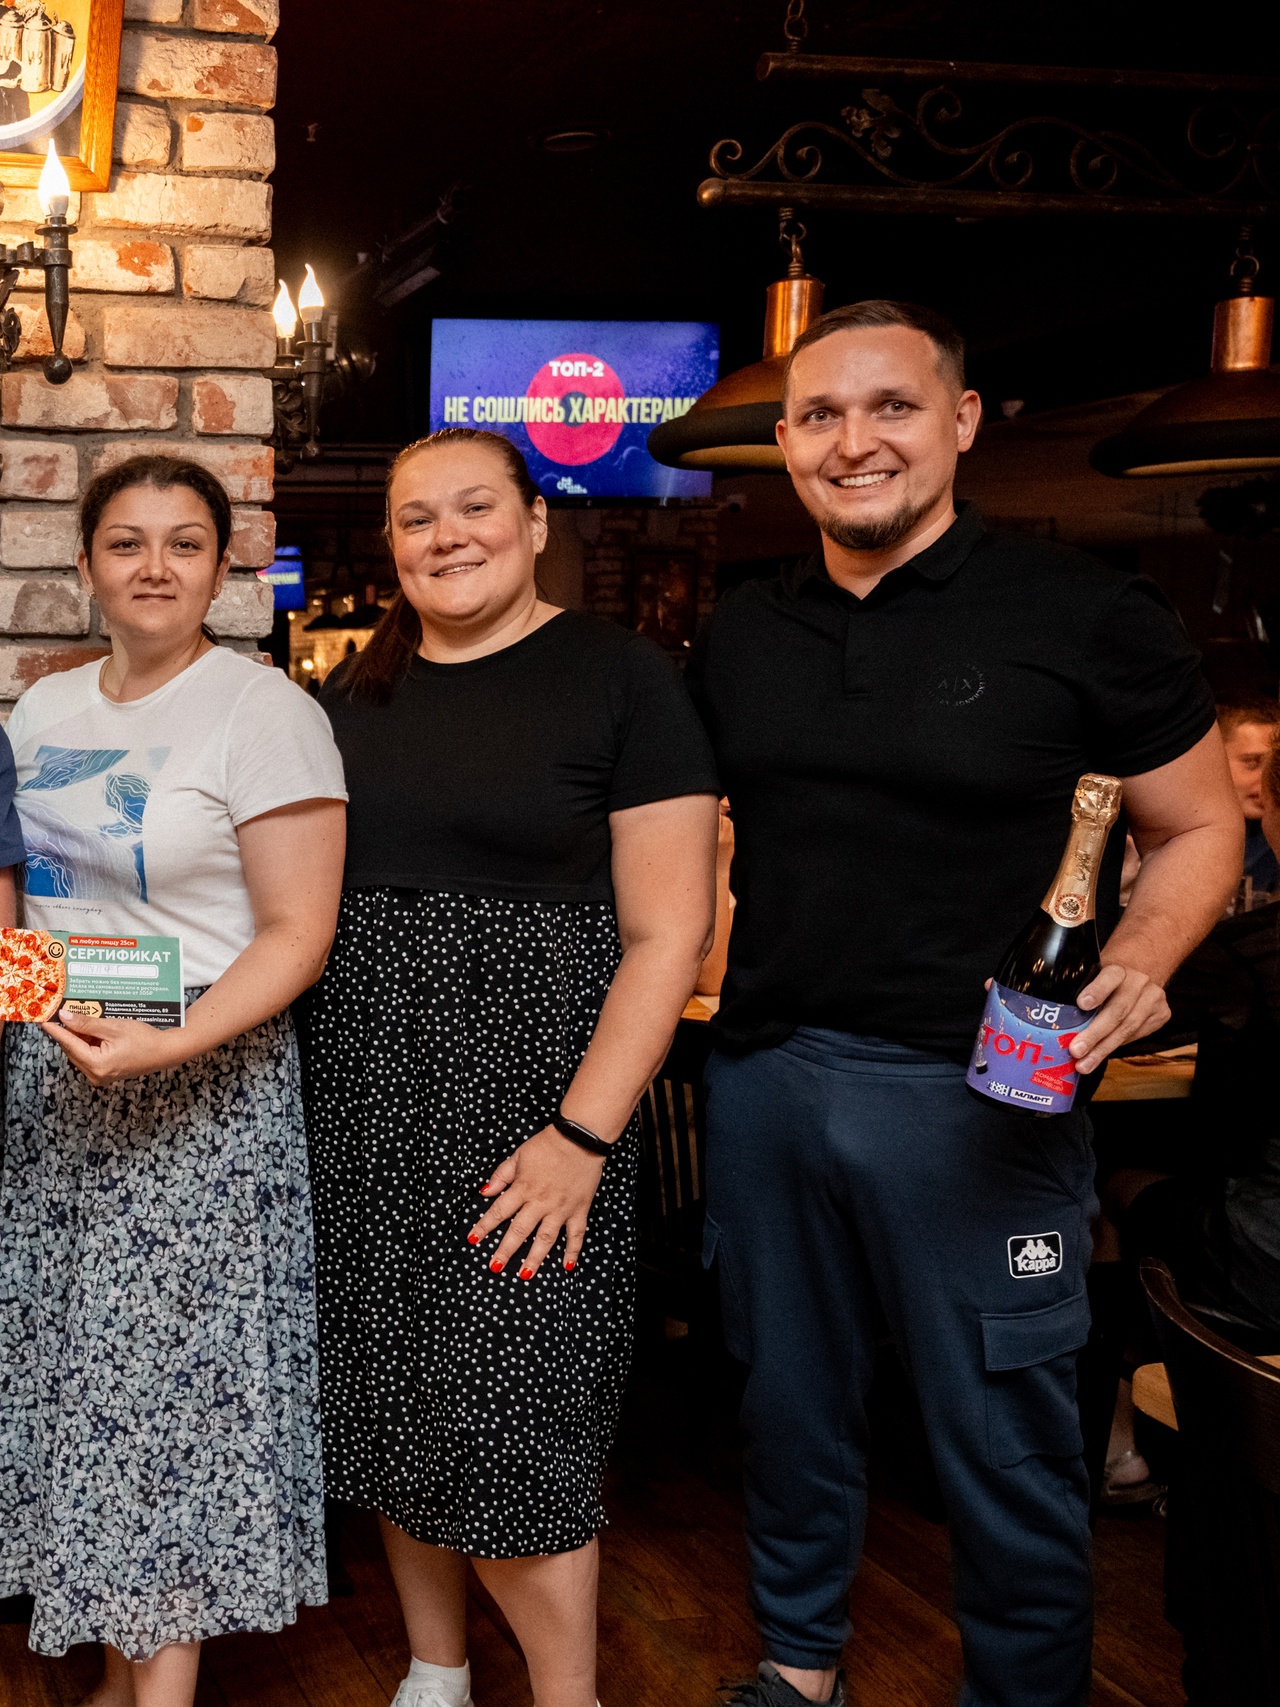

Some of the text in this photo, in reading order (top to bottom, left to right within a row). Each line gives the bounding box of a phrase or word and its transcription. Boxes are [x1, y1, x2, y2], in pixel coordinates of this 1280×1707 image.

[548, 361, 604, 377] ТОП-2
[444, 396, 697, 424] НЕ СОШЛИСЬ ХАРАКТЕРАМ
[68, 947, 171, 963] СЕРТИФИКАТ
[1017, 1257, 1056, 1272] Kappa
